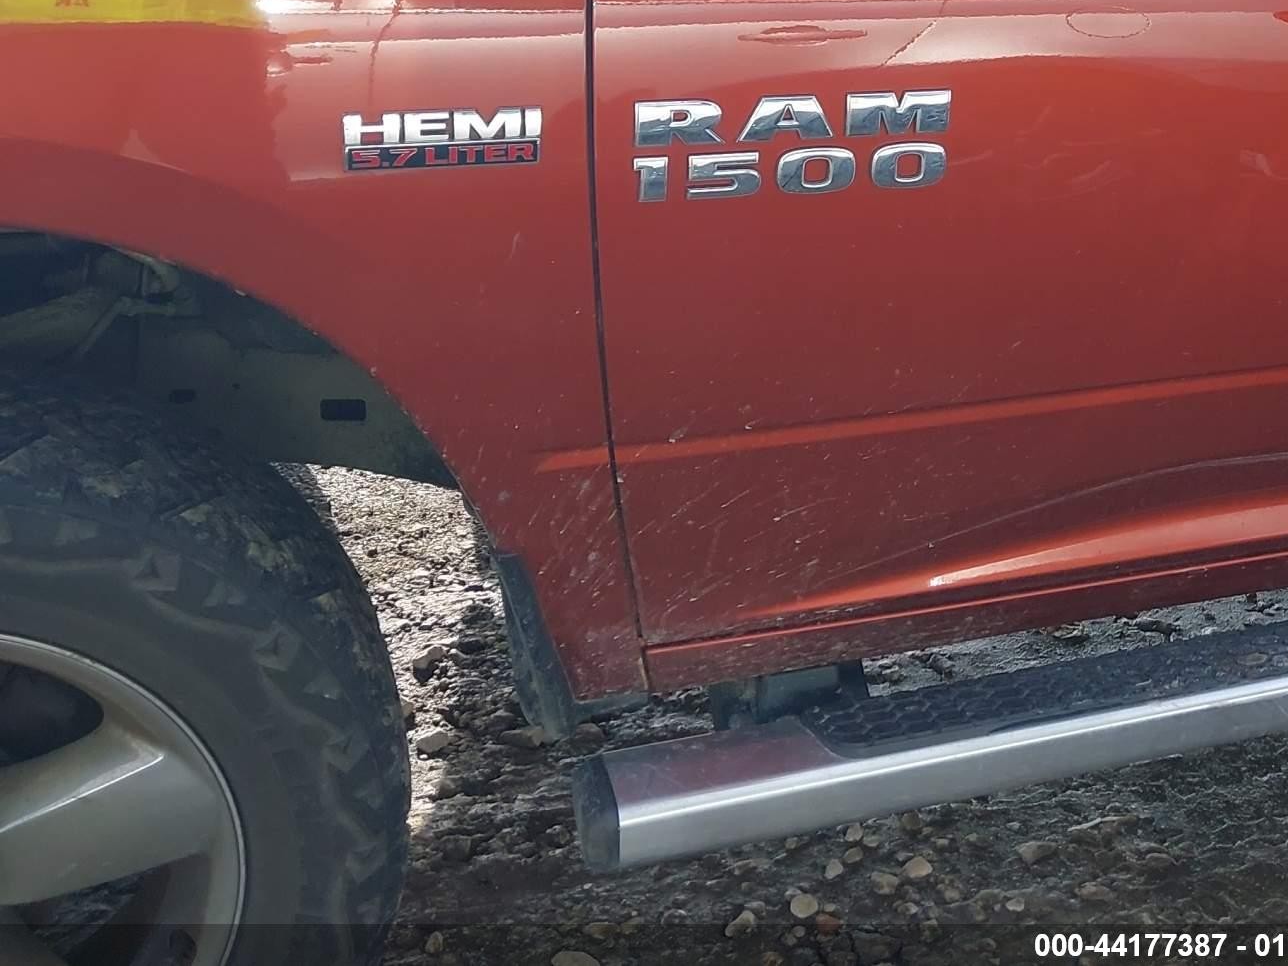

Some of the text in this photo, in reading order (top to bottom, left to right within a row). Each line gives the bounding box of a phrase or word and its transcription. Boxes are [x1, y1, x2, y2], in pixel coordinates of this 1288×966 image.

[343, 108, 542, 145] HEMI
[633, 90, 952, 148] RAM
[352, 143, 536, 169] 5.7 LITER
[633, 143, 948, 202] 1500
